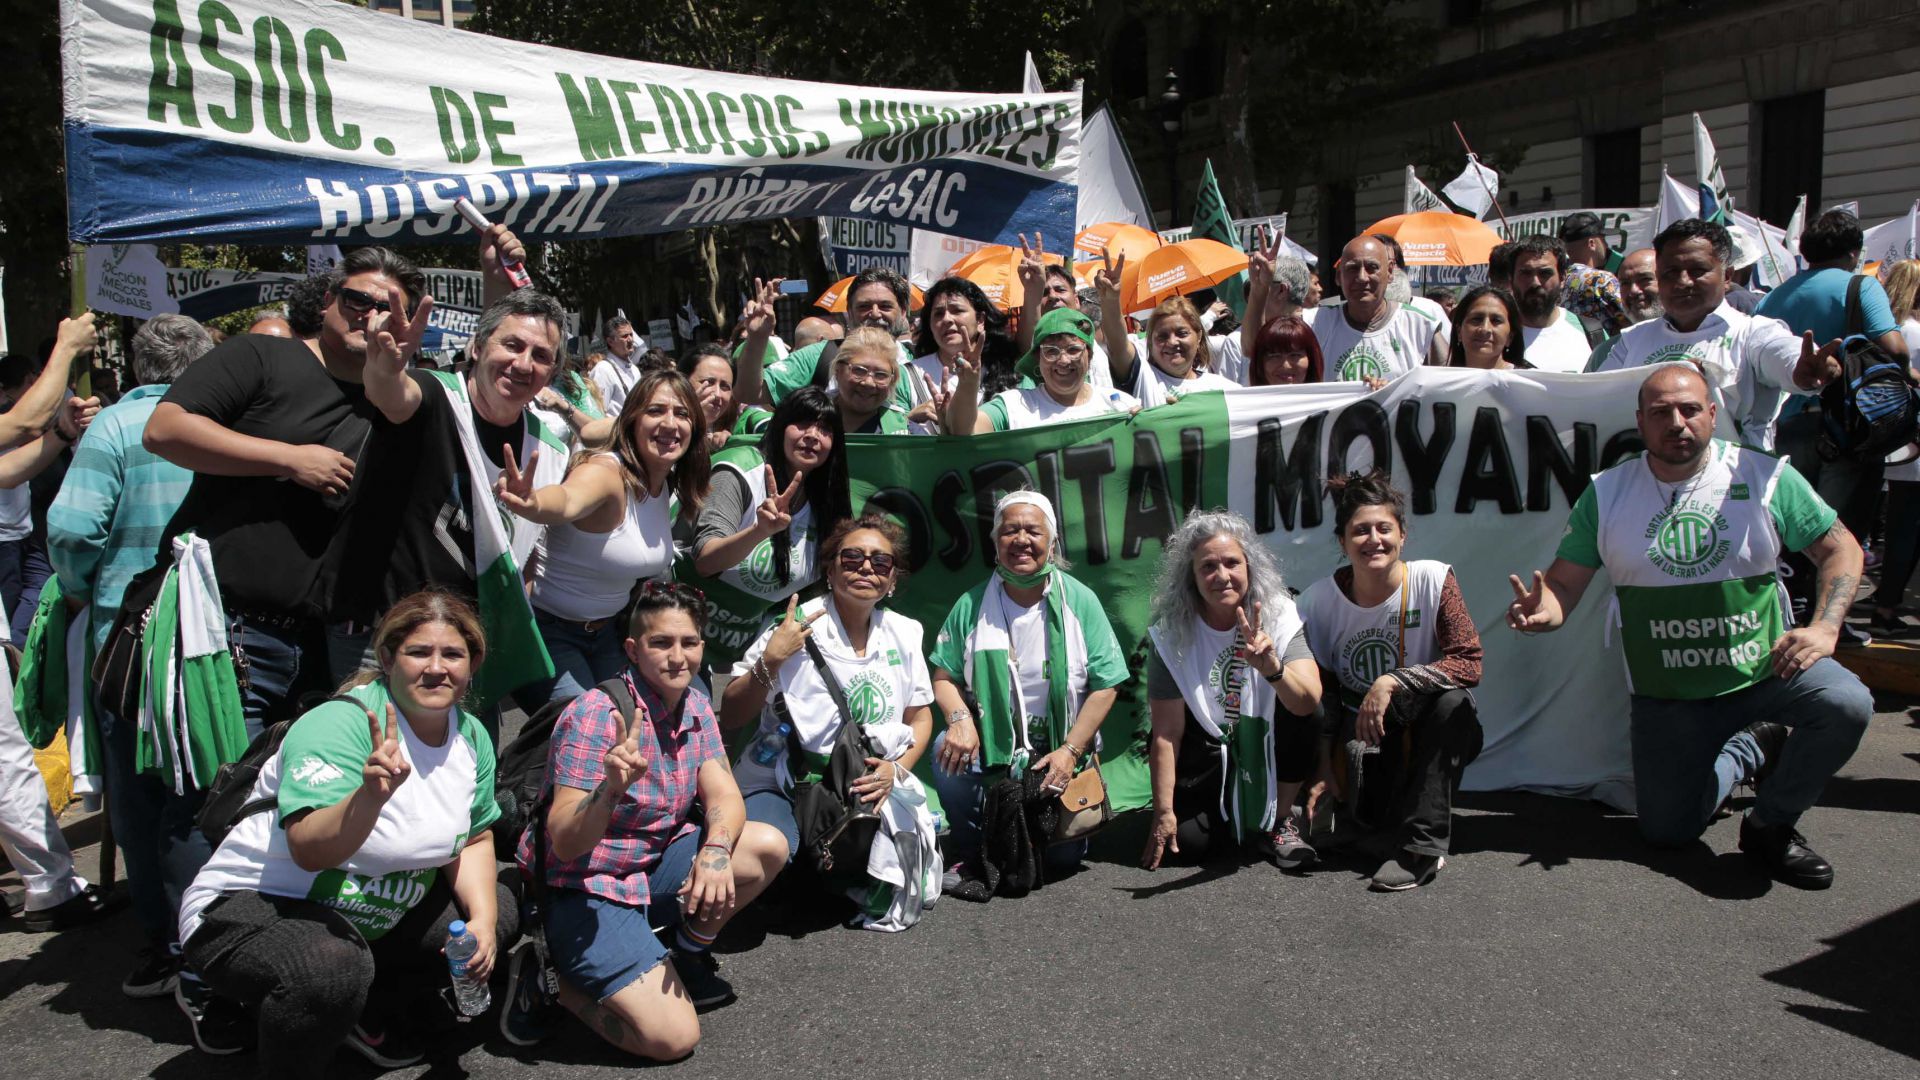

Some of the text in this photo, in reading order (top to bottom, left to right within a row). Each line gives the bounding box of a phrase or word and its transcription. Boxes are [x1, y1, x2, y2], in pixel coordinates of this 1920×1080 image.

[148, 0, 396, 155] ASOC.
[430, 86, 525, 166] DE
[555, 72, 830, 161] MEDICOS
[305, 172, 620, 237] HOSPITAL
[850, 168, 966, 228] CeSAC
[831, 217, 897, 249] MEDICOS
[1147, 265, 1184, 283] Nuevo
[1643, 343, 1687, 365] ORTALECER
[860, 427, 1205, 575] OSPITAL
[1690, 500, 1701, 510] EL
[1702, 503, 1729, 531] ESTADO
[1663, 518, 1710, 561] ATE
[1647, 540, 1732, 579] PARA LIBERAR LA NACION
[1649, 610, 1762, 639] HOSPITAL
[1342, 628, 1375, 660] FORTALECER
[1376, 628, 1385, 638] EL
[1661, 640, 1761, 668] MOYANO
[342, 872, 426, 908] SALUD
[545, 966, 559, 995] VANS
